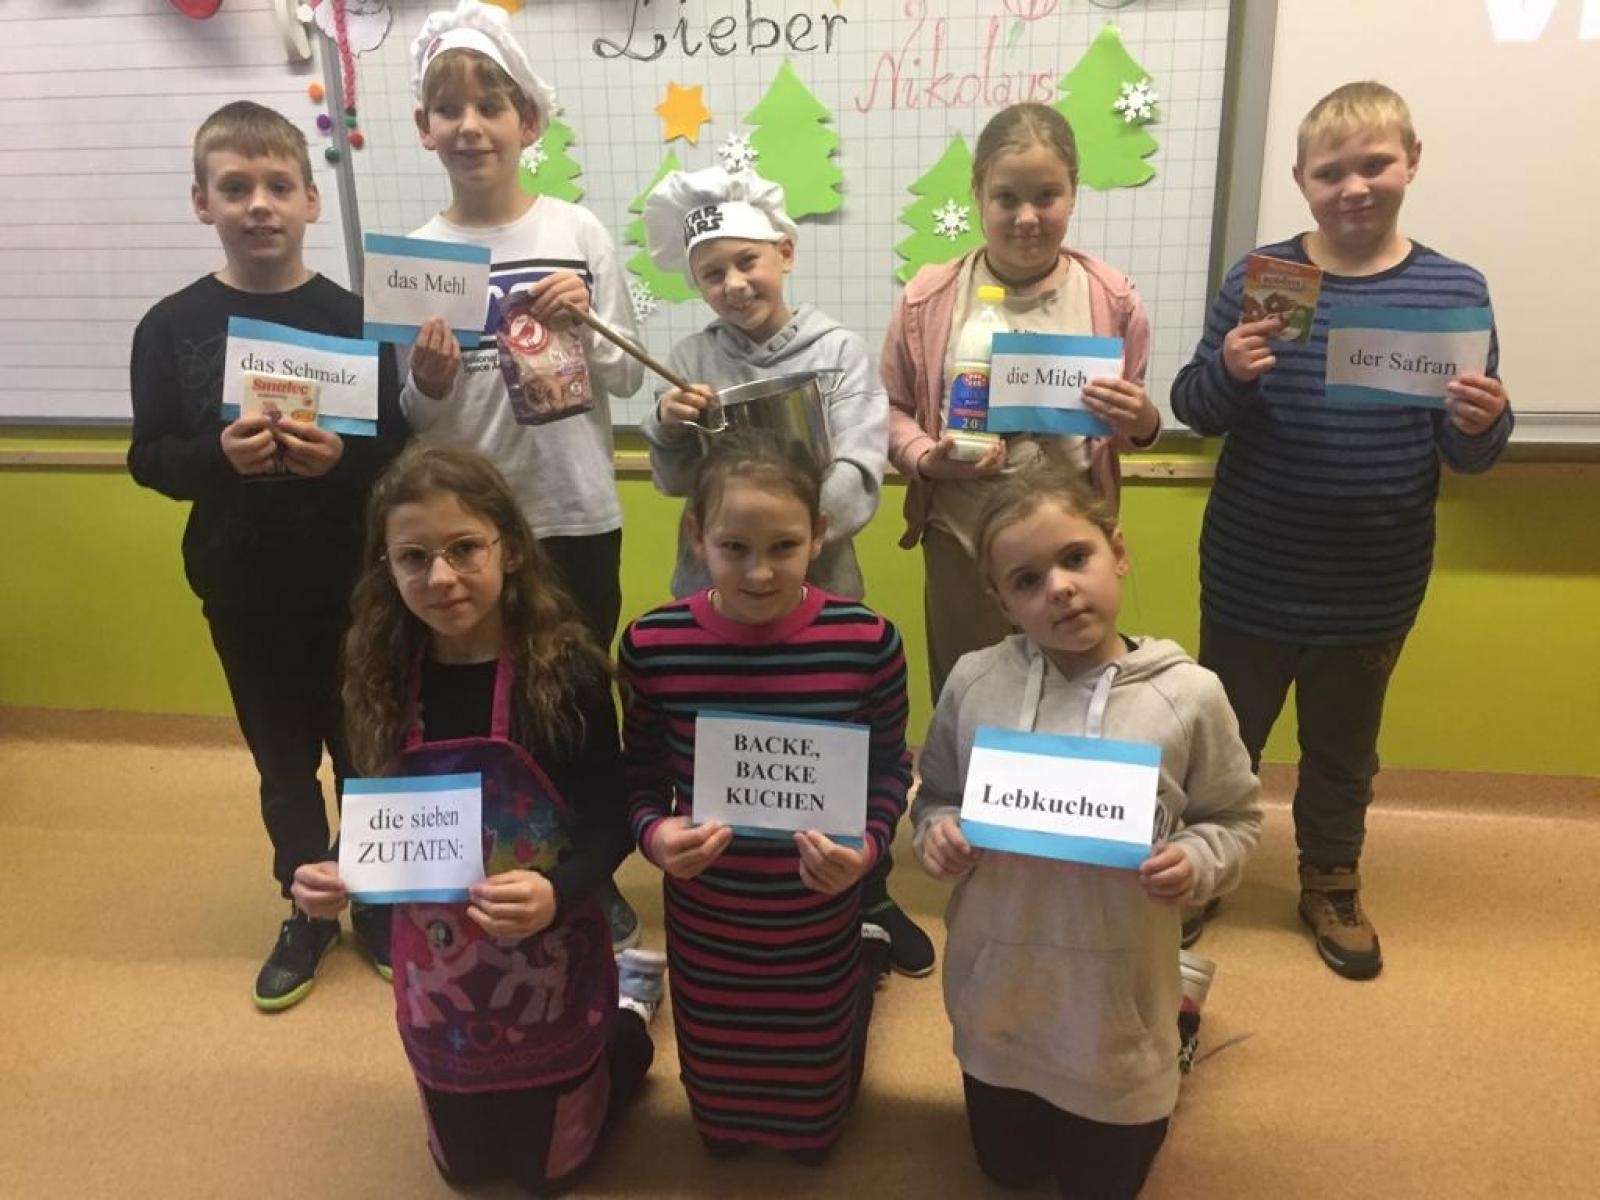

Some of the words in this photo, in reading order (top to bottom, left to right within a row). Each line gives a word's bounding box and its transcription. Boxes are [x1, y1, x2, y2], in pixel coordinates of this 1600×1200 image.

[592, 0, 848, 61] Lieber
[854, 2, 1053, 113] Nikolaus
[387, 270, 418, 290] das
[424, 272, 466, 297] Mehl
[240, 352, 276, 374] das
[282, 358, 358, 386] Schmalz
[1349, 349, 1384, 367] der
[1388, 352, 1458, 376] Safran
[1006, 366, 1029, 385] die
[1035, 368, 1088, 388] Milch
[734, 733, 822, 760] BACKE,
[736, 760, 817, 785] BACKE
[725, 786, 826, 812] KUCHEN
[982, 783, 1126, 821] Lebkuchen
[369, 807, 404, 831] die
[410, 804, 460, 829] sieben
[357, 838, 464, 864] ZUTATEN:
